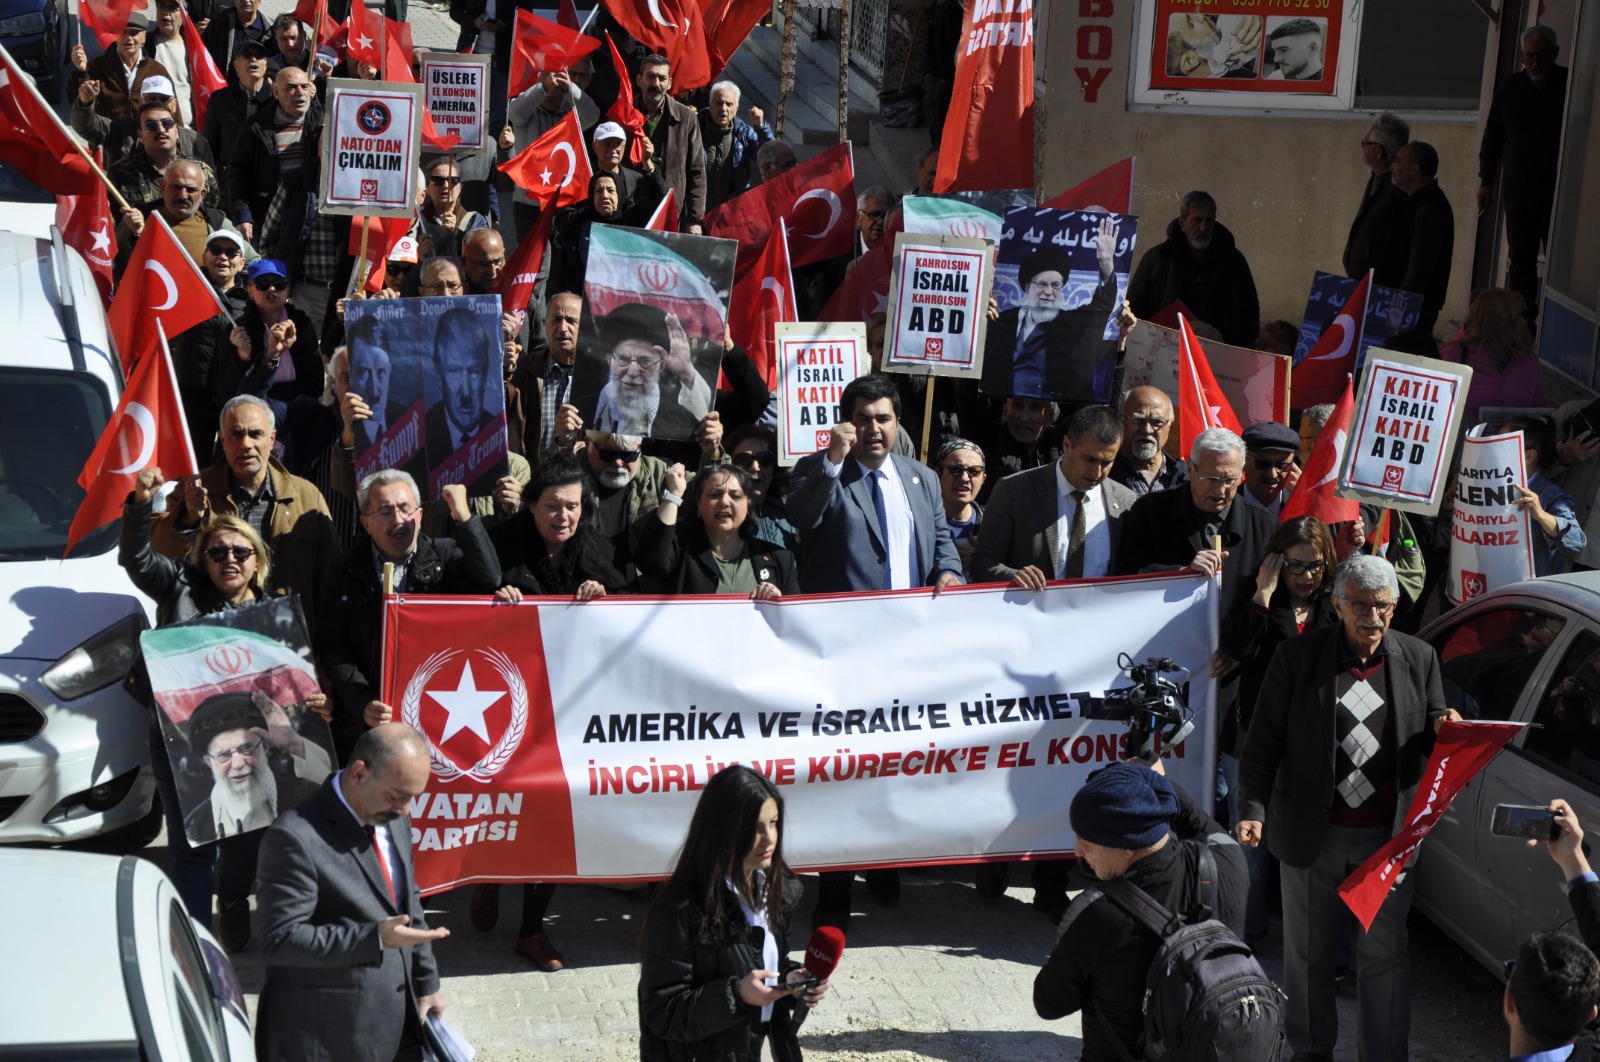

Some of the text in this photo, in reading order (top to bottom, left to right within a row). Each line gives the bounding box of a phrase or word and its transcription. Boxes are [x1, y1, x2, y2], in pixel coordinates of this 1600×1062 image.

[432, 71, 477, 86] ÜSLERE
[432, 87, 476, 98] EL KONSUN
[431, 100, 476, 112] AMERİKA
[432, 114, 476, 125] DEFOLSUN!
[340, 137, 402, 153] NATO'DAN
[338, 152, 402, 171] ÇIKALIM
[915, 257, 971, 271] KAHROLSUN
[912, 268, 969, 293] İSRAİL
[911, 293, 967, 307] KAHROLSUN
[908, 306, 965, 335] ABD
[796, 345, 844, 366] KATİL
[797, 366, 844, 383] İSRAİL
[1384, 376, 1439, 403] KATİL
[1380, 395, 1435, 421] İSRAİL
[1374, 416, 1431, 443] KATİL
[1371, 437, 1425, 465] ABD
[582, 705, 746, 743] AMERİKA
[758, 712, 801, 738] VE
[812, 699, 951, 737] İSRAİL'E
[960, 691, 1092, 728] HİZMET
[807, 742, 990, 784] KÜRECİK'E
[997, 742, 1036, 769] EL
[1047, 731, 1186, 766] KONSN
[410, 792, 523, 820] VATAN
